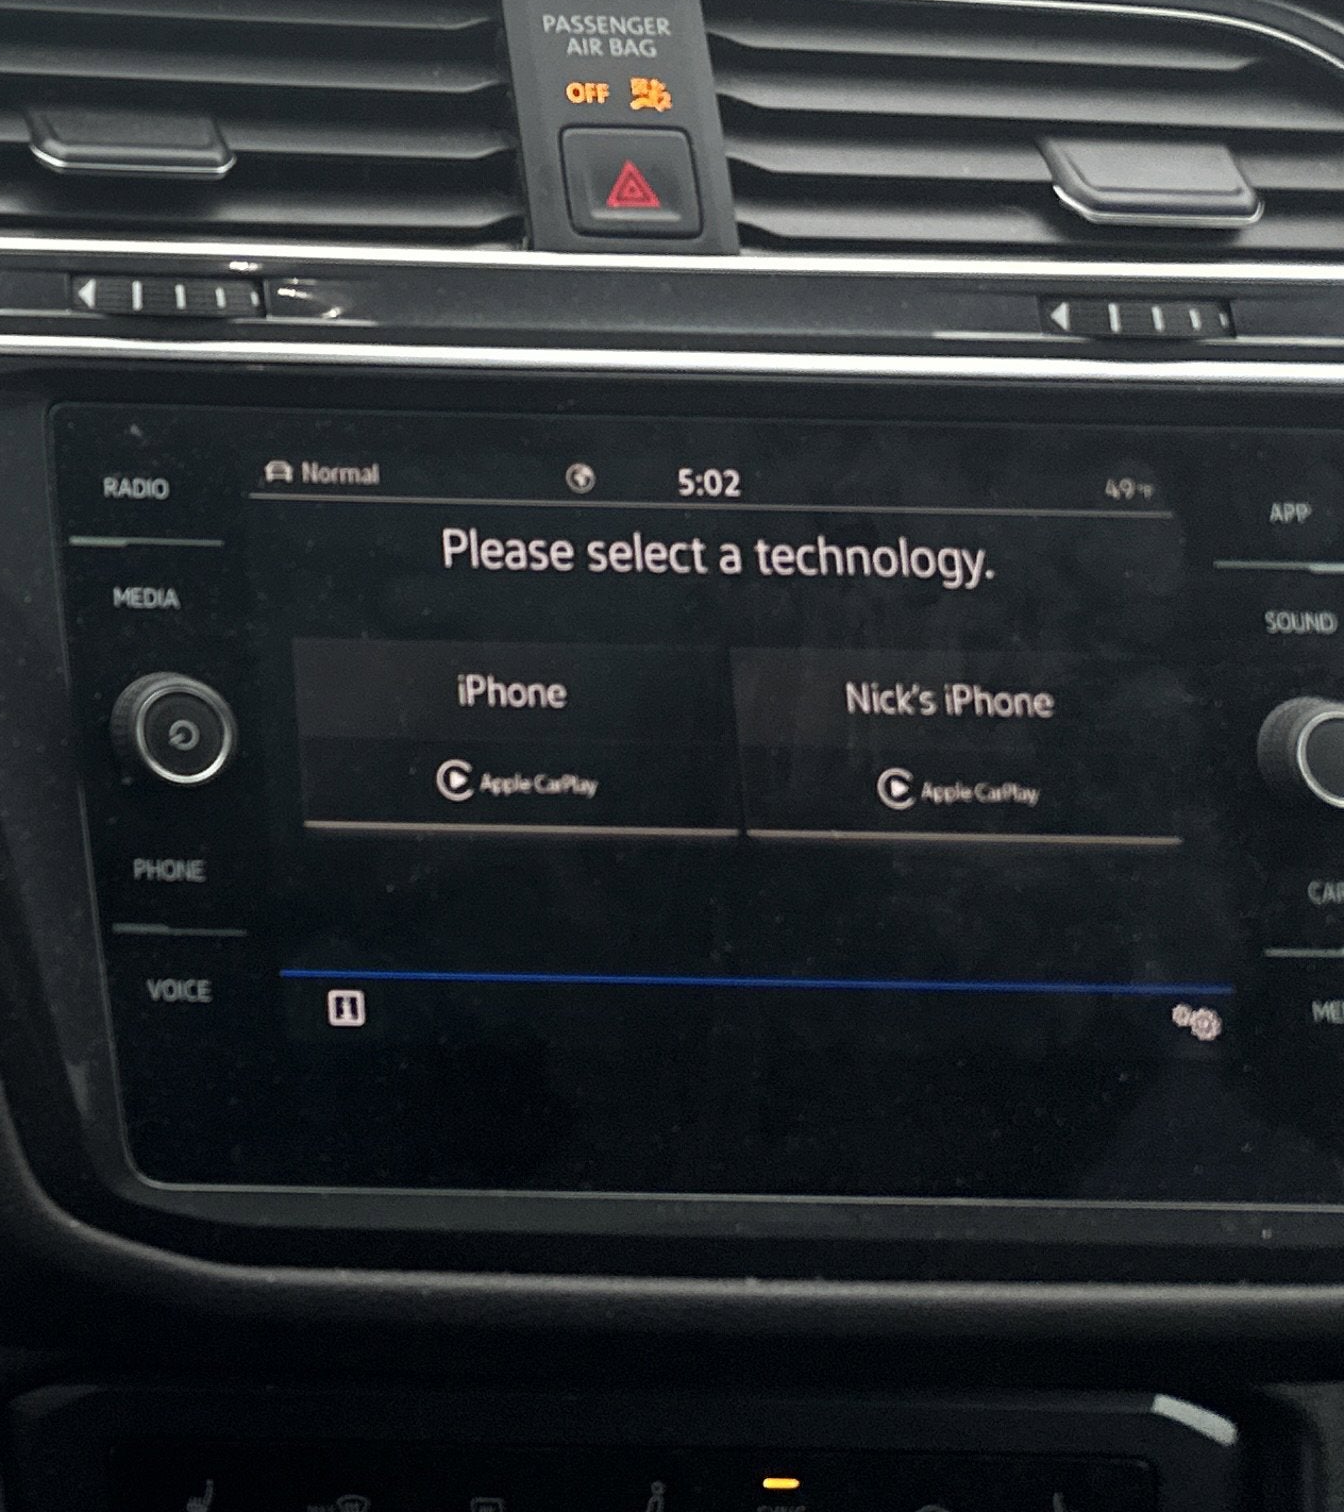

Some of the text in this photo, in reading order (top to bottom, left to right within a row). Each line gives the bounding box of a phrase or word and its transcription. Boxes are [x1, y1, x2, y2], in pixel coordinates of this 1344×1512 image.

[542, 15, 671, 36] PASSENGER
[567, 38, 657, 58] AIR BAG
[566, 82, 610, 104] OFF
[302, 461, 380, 486] Normal
[678, 468, 741, 498] 5:02
[104, 476, 170, 500] RADIO
[1269, 502, 1312, 524] APP
[443, 528, 996, 589] Please select a technology.
[113, 586, 180, 610] MEDIA
[1264, 610, 1338, 635] SOUND
[457, 673, 569, 709] iPhone
[846, 681, 1055, 719] Nick's iPhone
[479, 772, 599, 799] Apple CarPlay
[921, 782, 1039, 808] Apple CarPlay
[133, 858, 206, 884] PHONE
[147, 978, 212, 1004] VOICE
